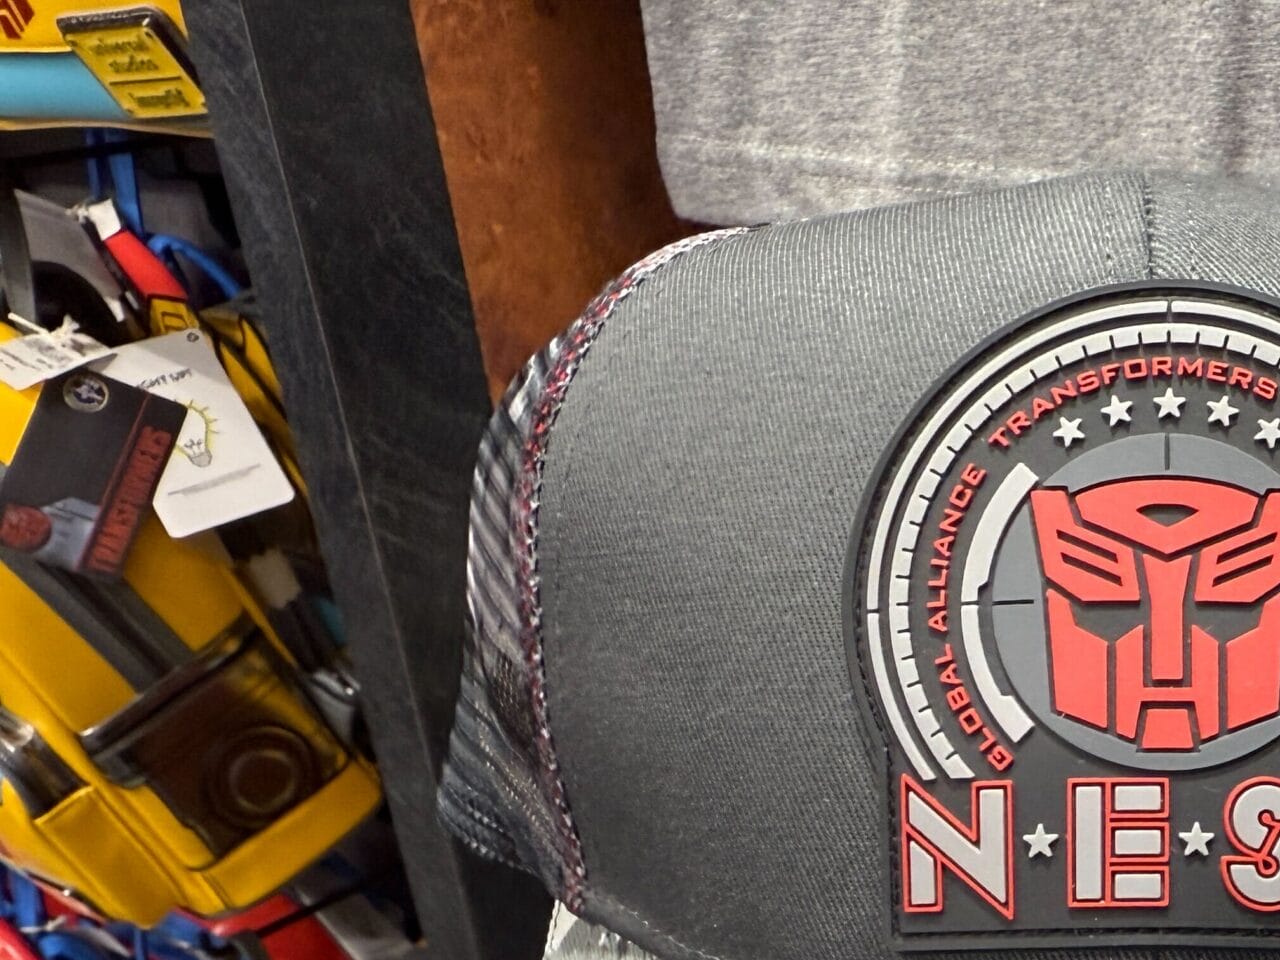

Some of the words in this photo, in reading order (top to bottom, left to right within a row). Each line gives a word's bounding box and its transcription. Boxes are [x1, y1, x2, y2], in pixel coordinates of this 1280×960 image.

[988, 355, 1278, 447] TRANSFORMERS
[926, 463, 987, 633] ALLIANCE
[934, 643, 1014, 772] GLOBAL
